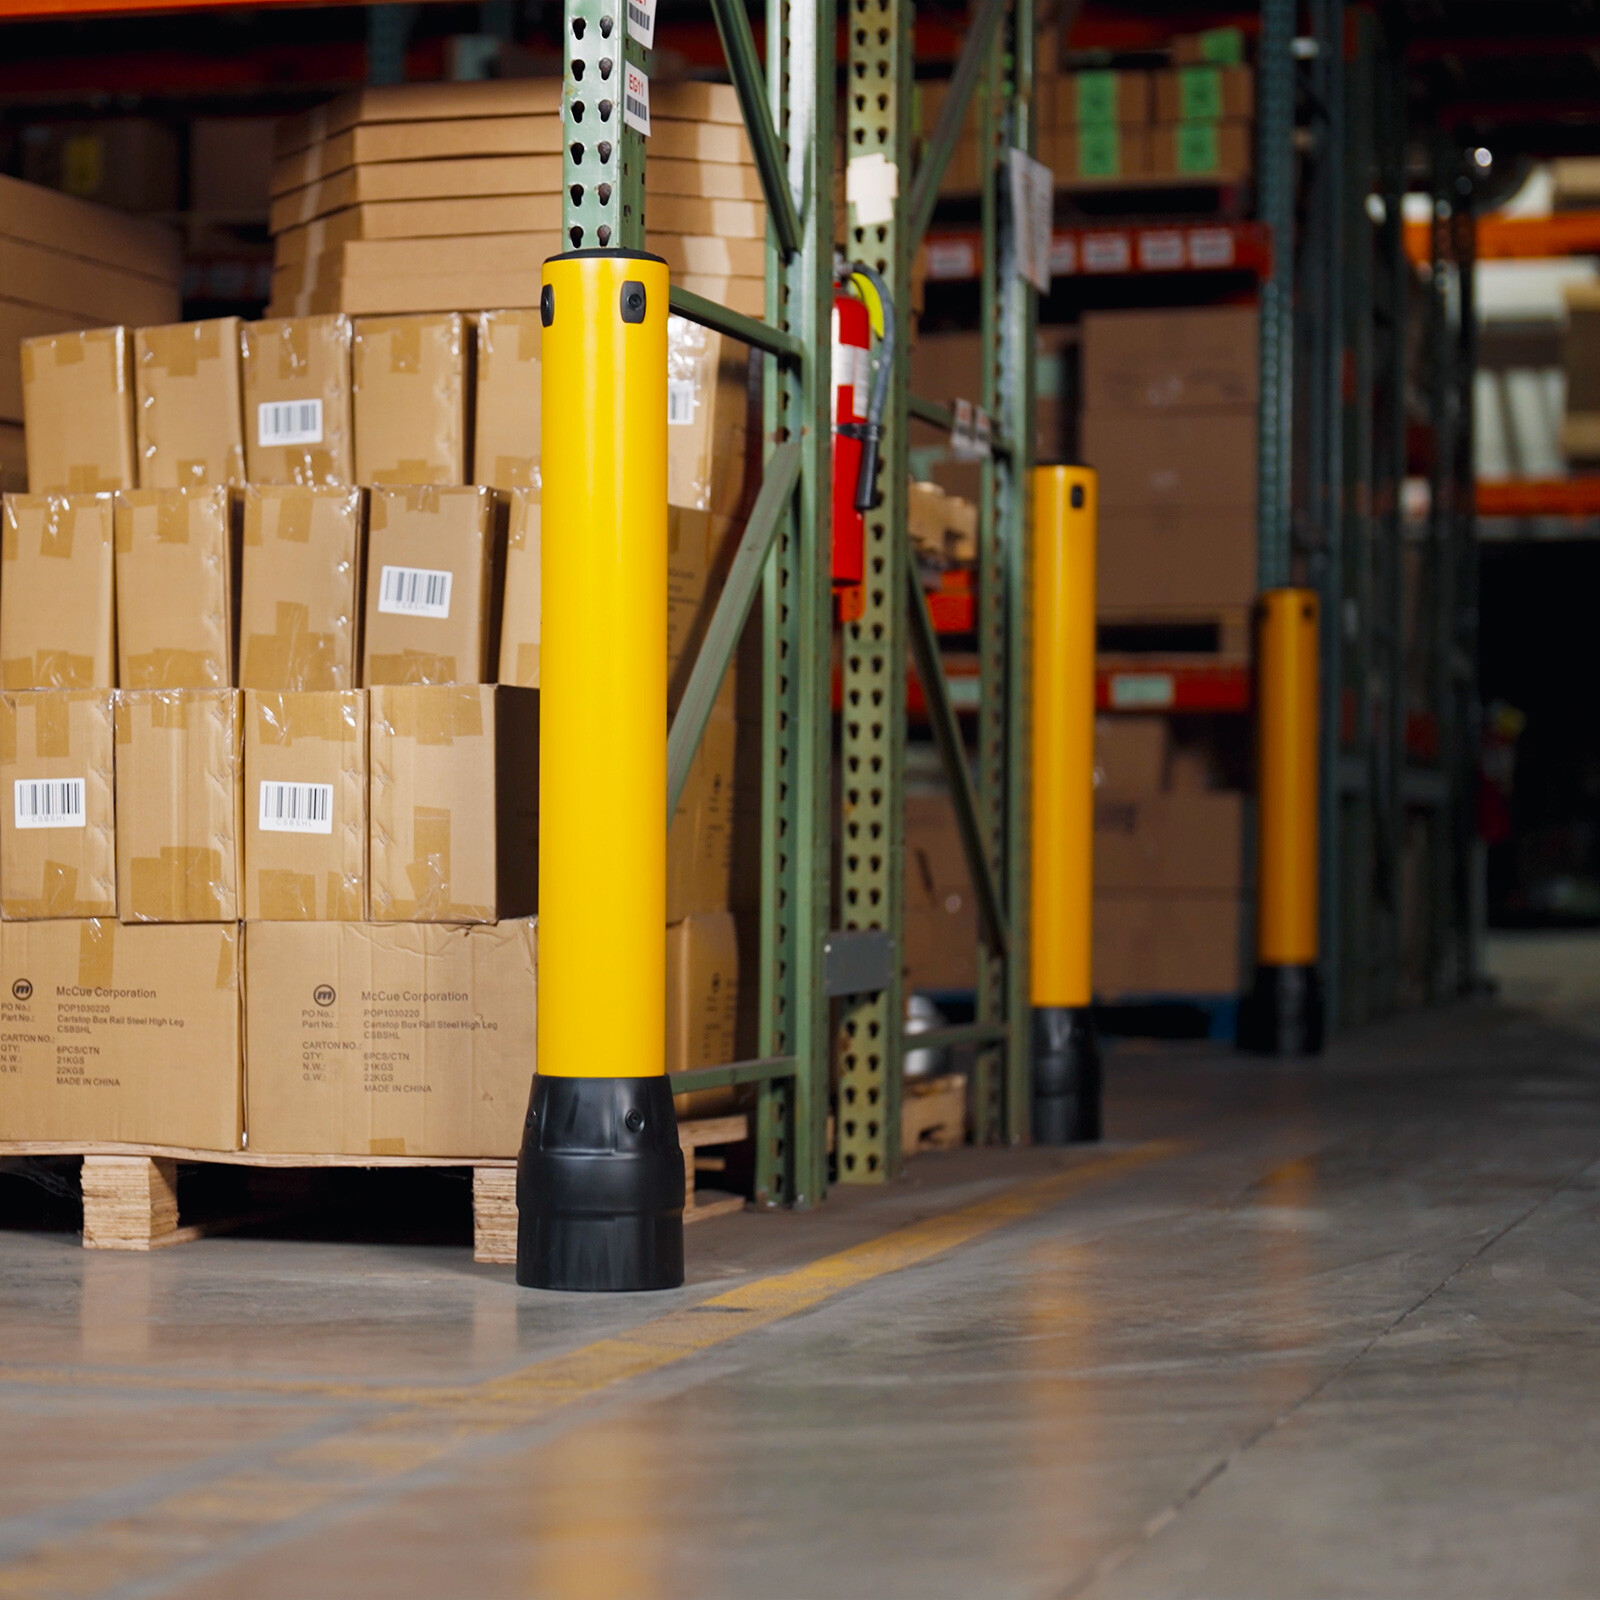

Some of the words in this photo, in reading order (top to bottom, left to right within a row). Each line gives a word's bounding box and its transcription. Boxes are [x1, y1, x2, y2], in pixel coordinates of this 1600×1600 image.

[629, 73, 644, 97] EG11
[56, 986, 92, 996] McCue
[95, 987, 157, 999] Corporation
[361, 991, 400, 1001] McCue
[402, 991, 469, 1002] Corporation
[1, 1003, 14, 1011] PO
[58, 1004, 111, 1013] POP1030220
[1, 1013, 18, 1021] Part
[302, 1009, 315, 1018] PO
[363, 1009, 420, 1018] POP1030220
[92, 1015, 108, 1024] Box
[110, 1016, 125, 1024] Rail
[127, 1016, 148, 1025] Steel
[149, 1017, 168, 1027] High
[169, 1018, 184, 1028] Leg
[302, 1020, 320, 1029] Part
[401, 1020, 417, 1029] Box
[420, 1021, 436, 1029] Rail
[437, 1021, 460, 1030] Steel
[461, 1021, 480, 1031] High
[482, 1021, 498, 1031] Leg
[57, 1025, 91, 1034] CSBSHL
[1, 1033, 36, 1043] CARTON
[363, 1031, 400, 1040] CSBSHL
[56, 1046, 100, 1054] 6PCS/CTN
[303, 1041, 340, 1050] CARTON
[303, 1051, 324, 1060] QTY:
[363, 1052, 410, 1061] 6PCS/CTN
[57, 1056, 85, 1065] 21KGS
[57, 1066, 85, 1075] 22KGS
[303, 1062, 326, 1071] N.W.:
[364, 1063, 394, 1071] 21KGS
[57, 1077, 80, 1086] MADE
[83, 1078, 91, 1086] IN
[93, 1078, 120, 1087] CHINA
[364, 1073, 394, 1082] 22KGS
[364, 1084, 390, 1092] MADE
[392, 1084, 401, 1092] IN
[403, 1084, 432, 1093] CHINA
